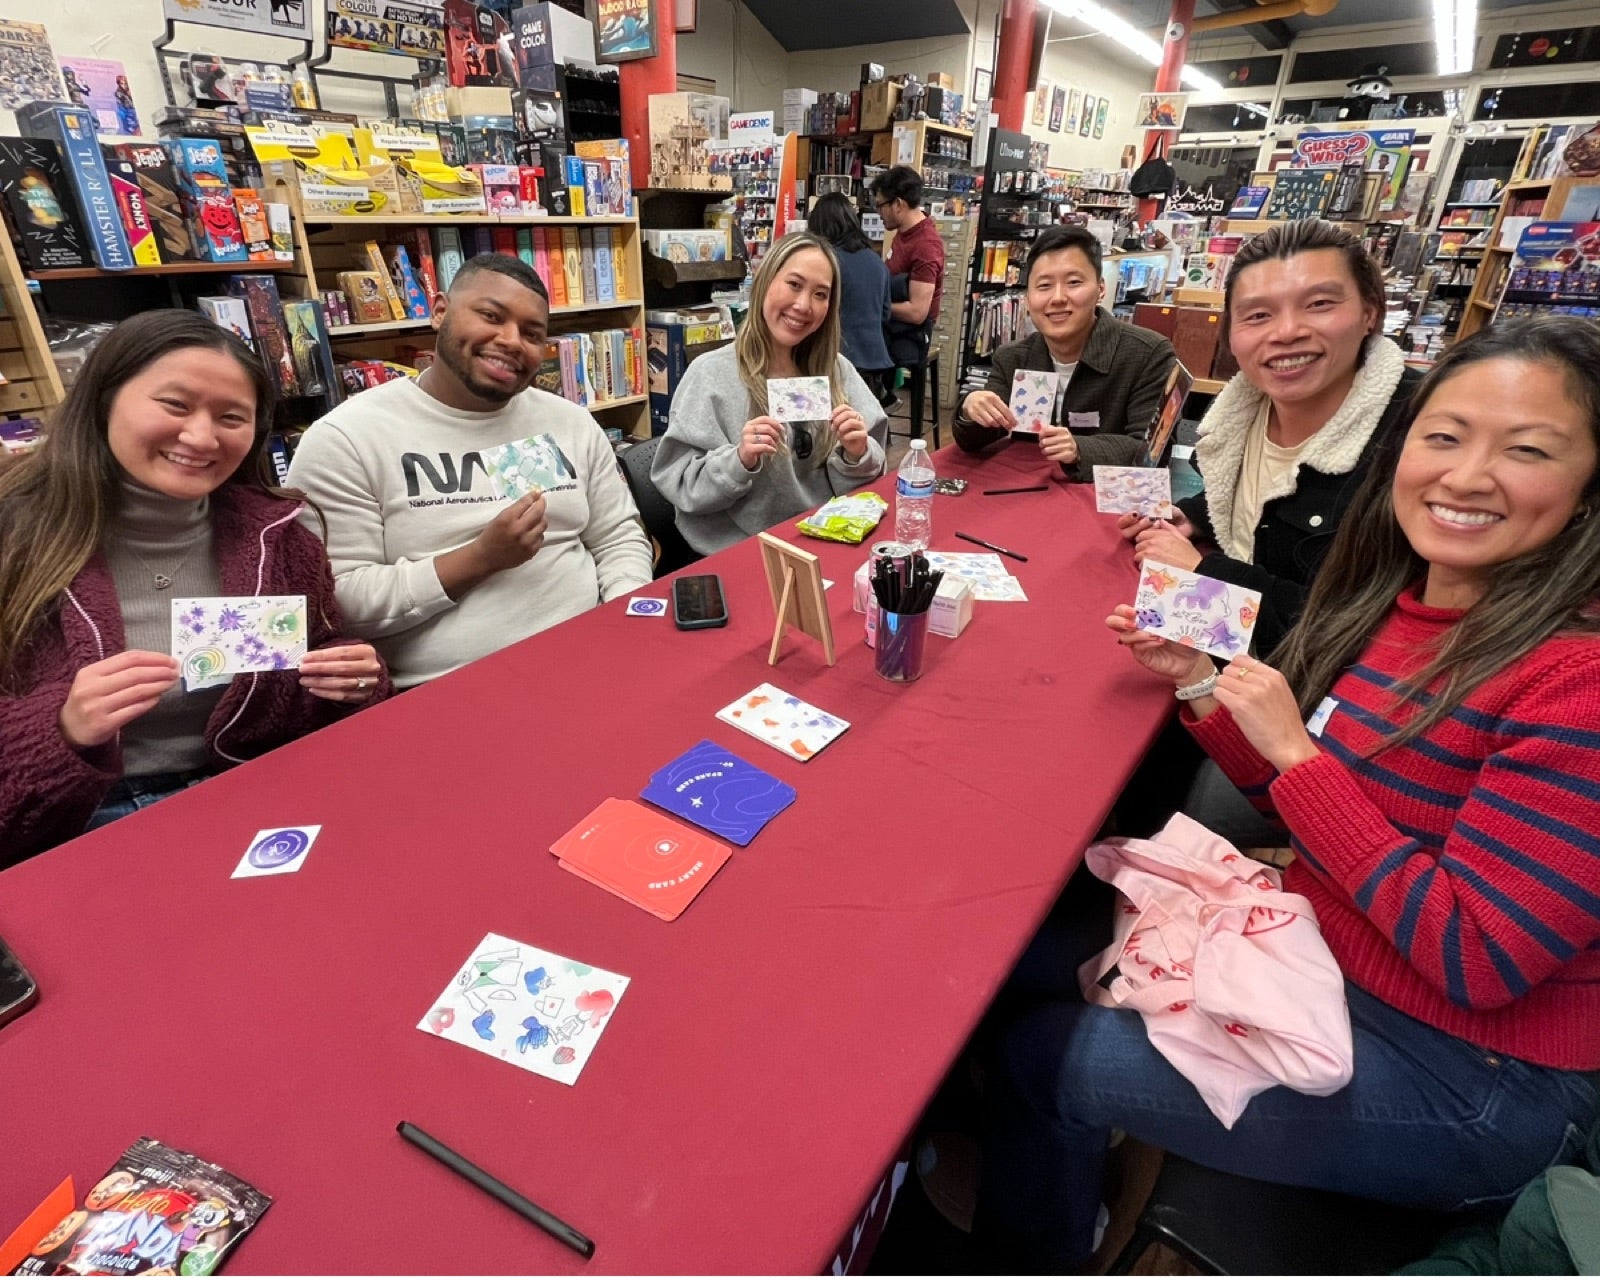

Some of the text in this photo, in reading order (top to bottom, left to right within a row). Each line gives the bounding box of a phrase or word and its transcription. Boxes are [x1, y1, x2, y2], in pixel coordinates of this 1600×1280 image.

[521, 20, 543, 35] GAME
[520, 33, 546, 49] COLOR
[731, 118, 770, 129] GAMEGENIC
[132, 147, 166, 168] Jenga
[307, 188, 325, 196] Other
[79, 148, 124, 263] HAMSTER ROLL
[401, 452, 577, 497] NA
[408, 498, 445, 509] National
[648, 860, 703, 889] HEART CARD
[141, 1166, 175, 1184] meiji
[76, 1209, 184, 1266] PANDA
